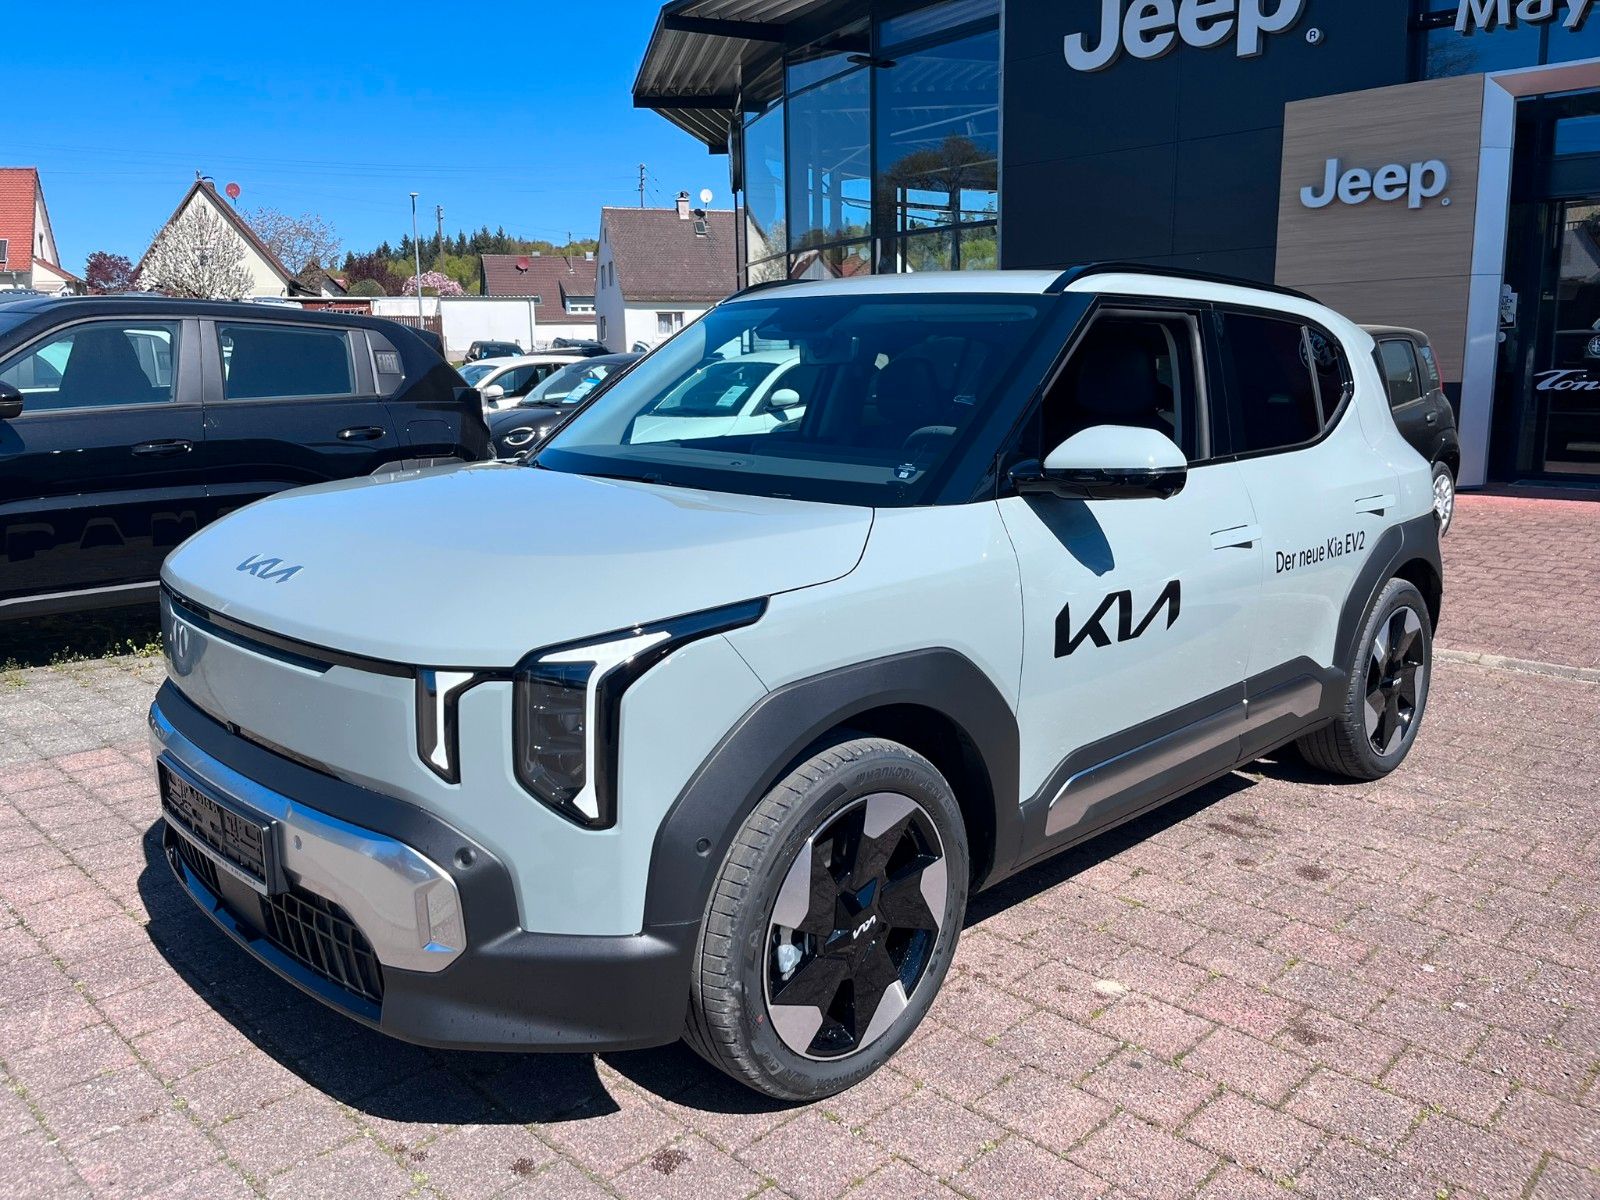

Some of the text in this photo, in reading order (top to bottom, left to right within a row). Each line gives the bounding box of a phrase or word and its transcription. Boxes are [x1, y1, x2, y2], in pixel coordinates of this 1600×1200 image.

[1063, 0, 1307, 72] Jeep
[1300, 158, 1448, 209] Jeep
[236, 553, 304, 584] KIA
[1275, 530, 1366, 574] Der neue Kia EV2
[1054, 579, 1181, 659] KIA
